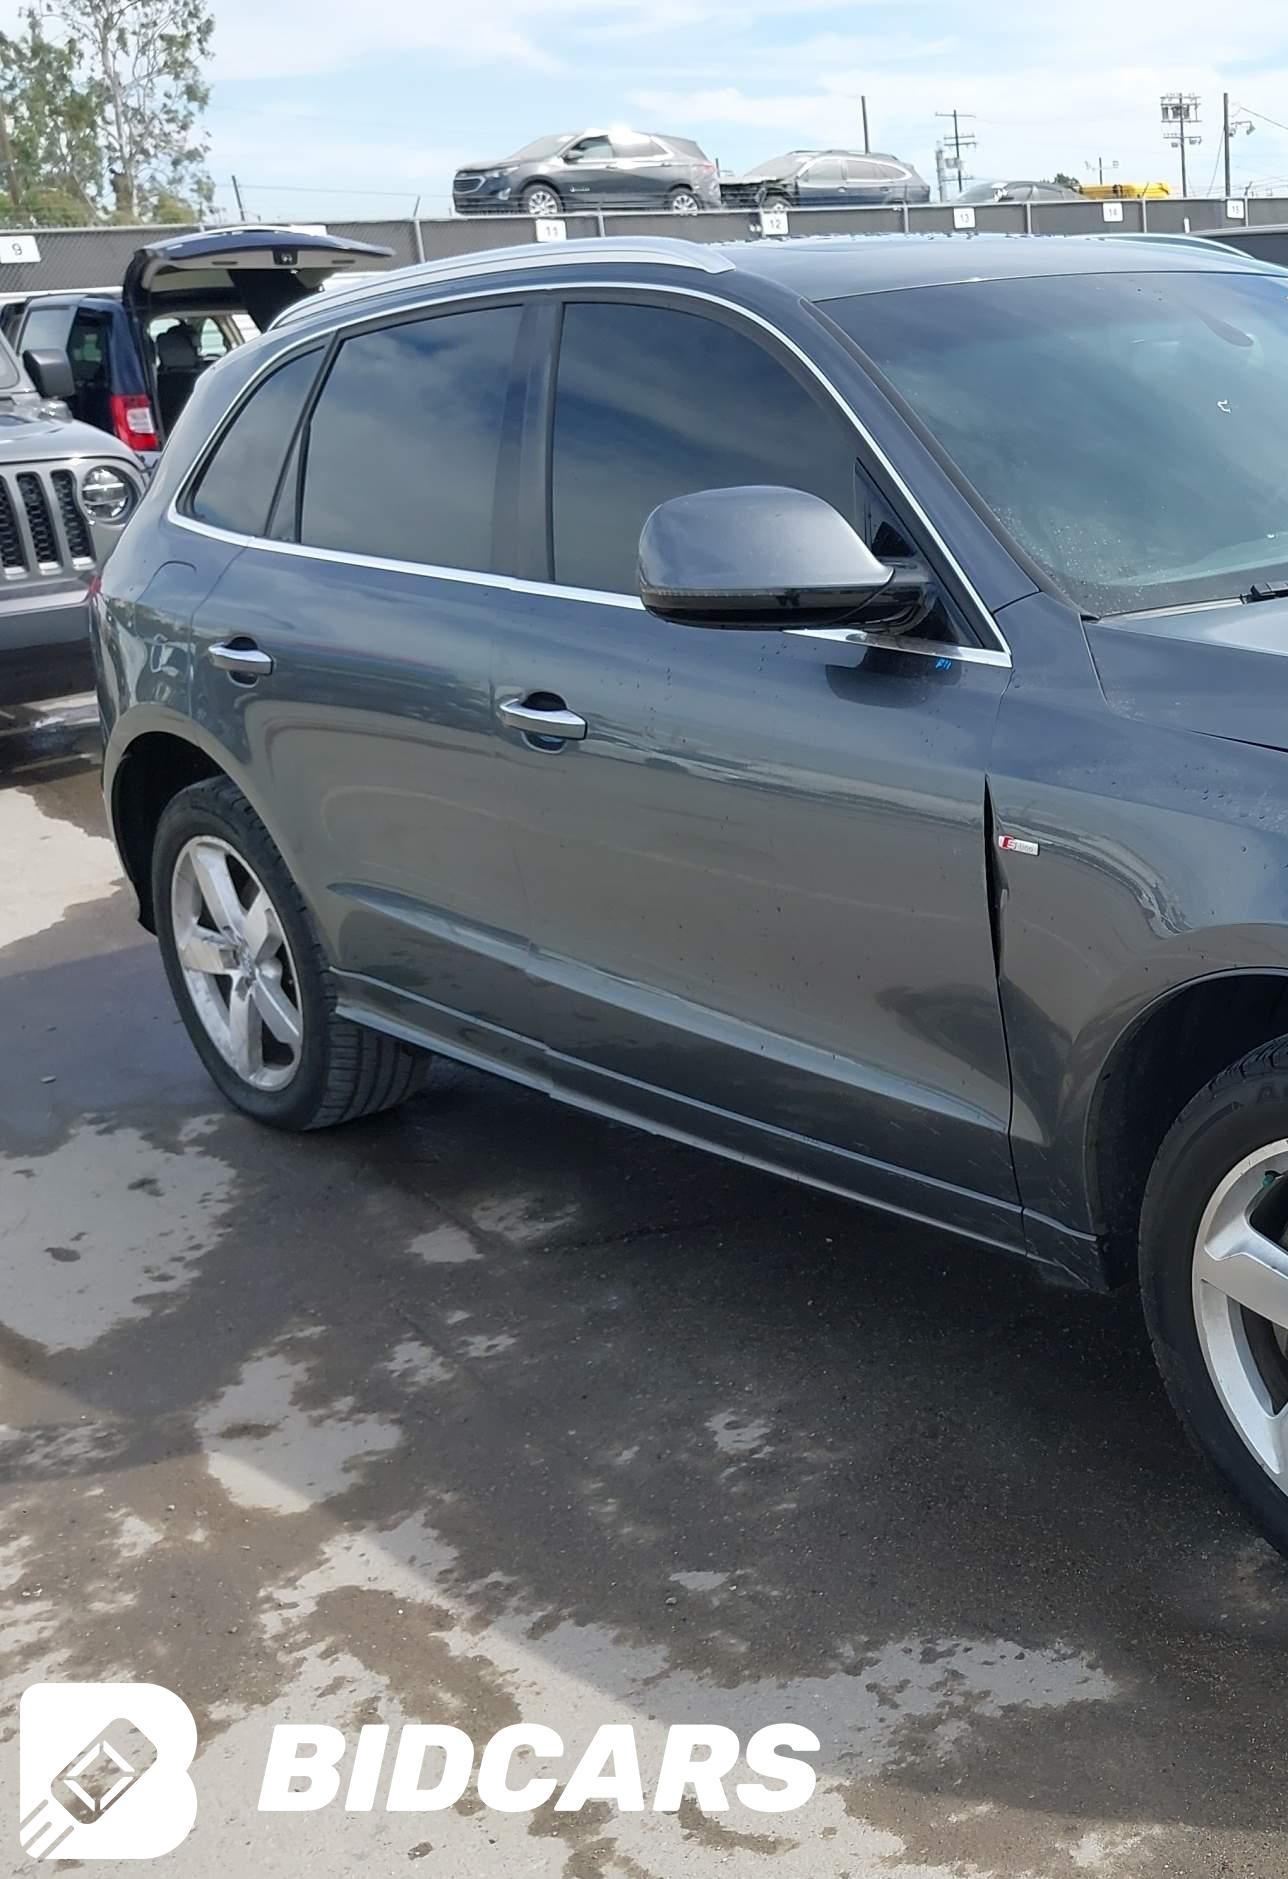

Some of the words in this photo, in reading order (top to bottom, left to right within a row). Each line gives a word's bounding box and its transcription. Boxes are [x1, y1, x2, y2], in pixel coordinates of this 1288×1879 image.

[768, 218, 782, 229] 12
[545, 225, 560, 237] 11
[11, 242, 23, 257] 9
